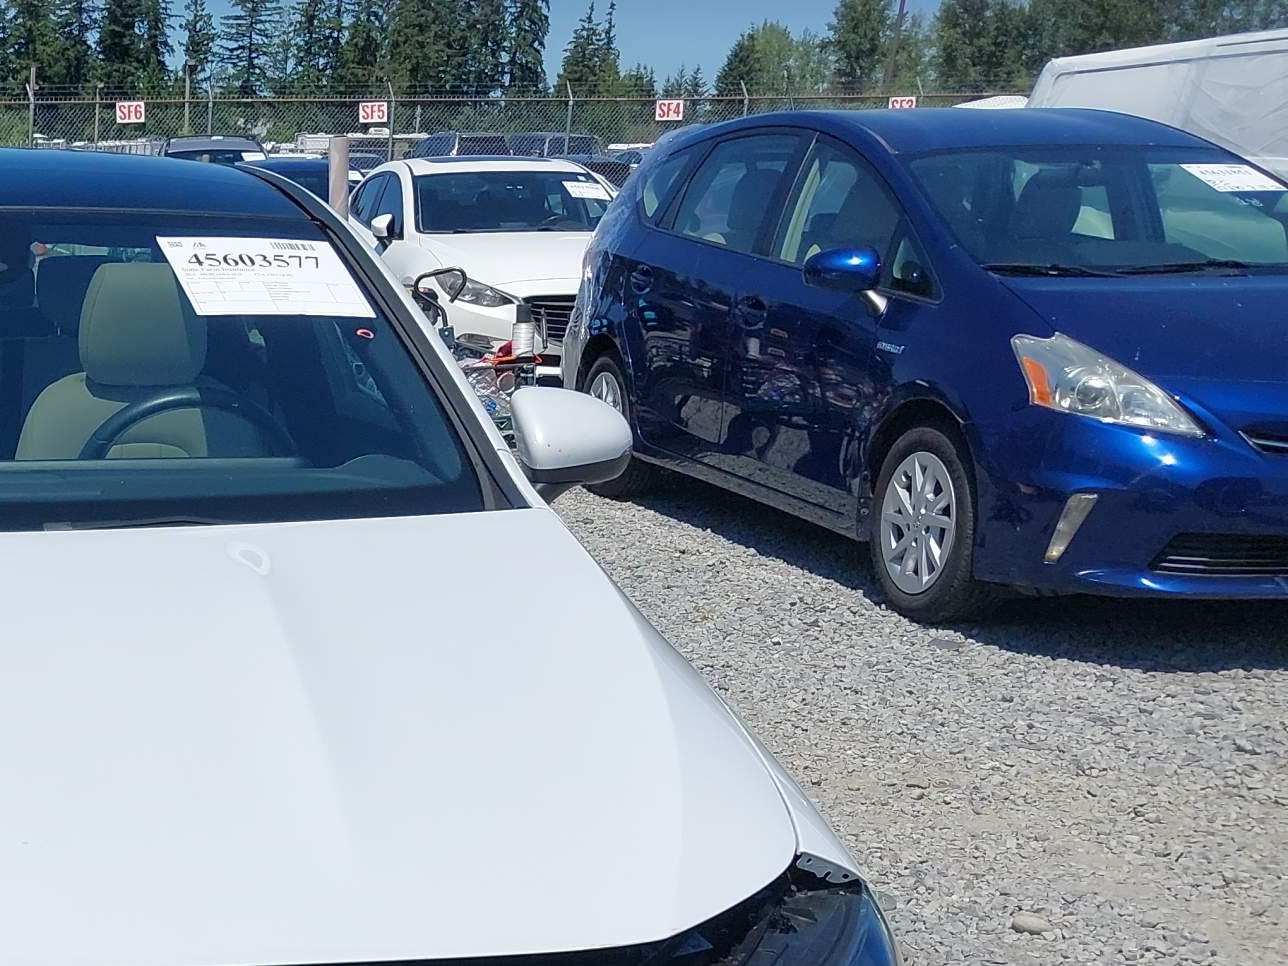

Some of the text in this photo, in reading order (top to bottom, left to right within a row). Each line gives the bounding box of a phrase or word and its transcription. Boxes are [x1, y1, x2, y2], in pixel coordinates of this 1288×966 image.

[119, 104, 142, 120] SF6
[361, 104, 385, 120] SF5
[658, 102, 681, 118] SF4
[188, 253, 319, 269] 45603577
